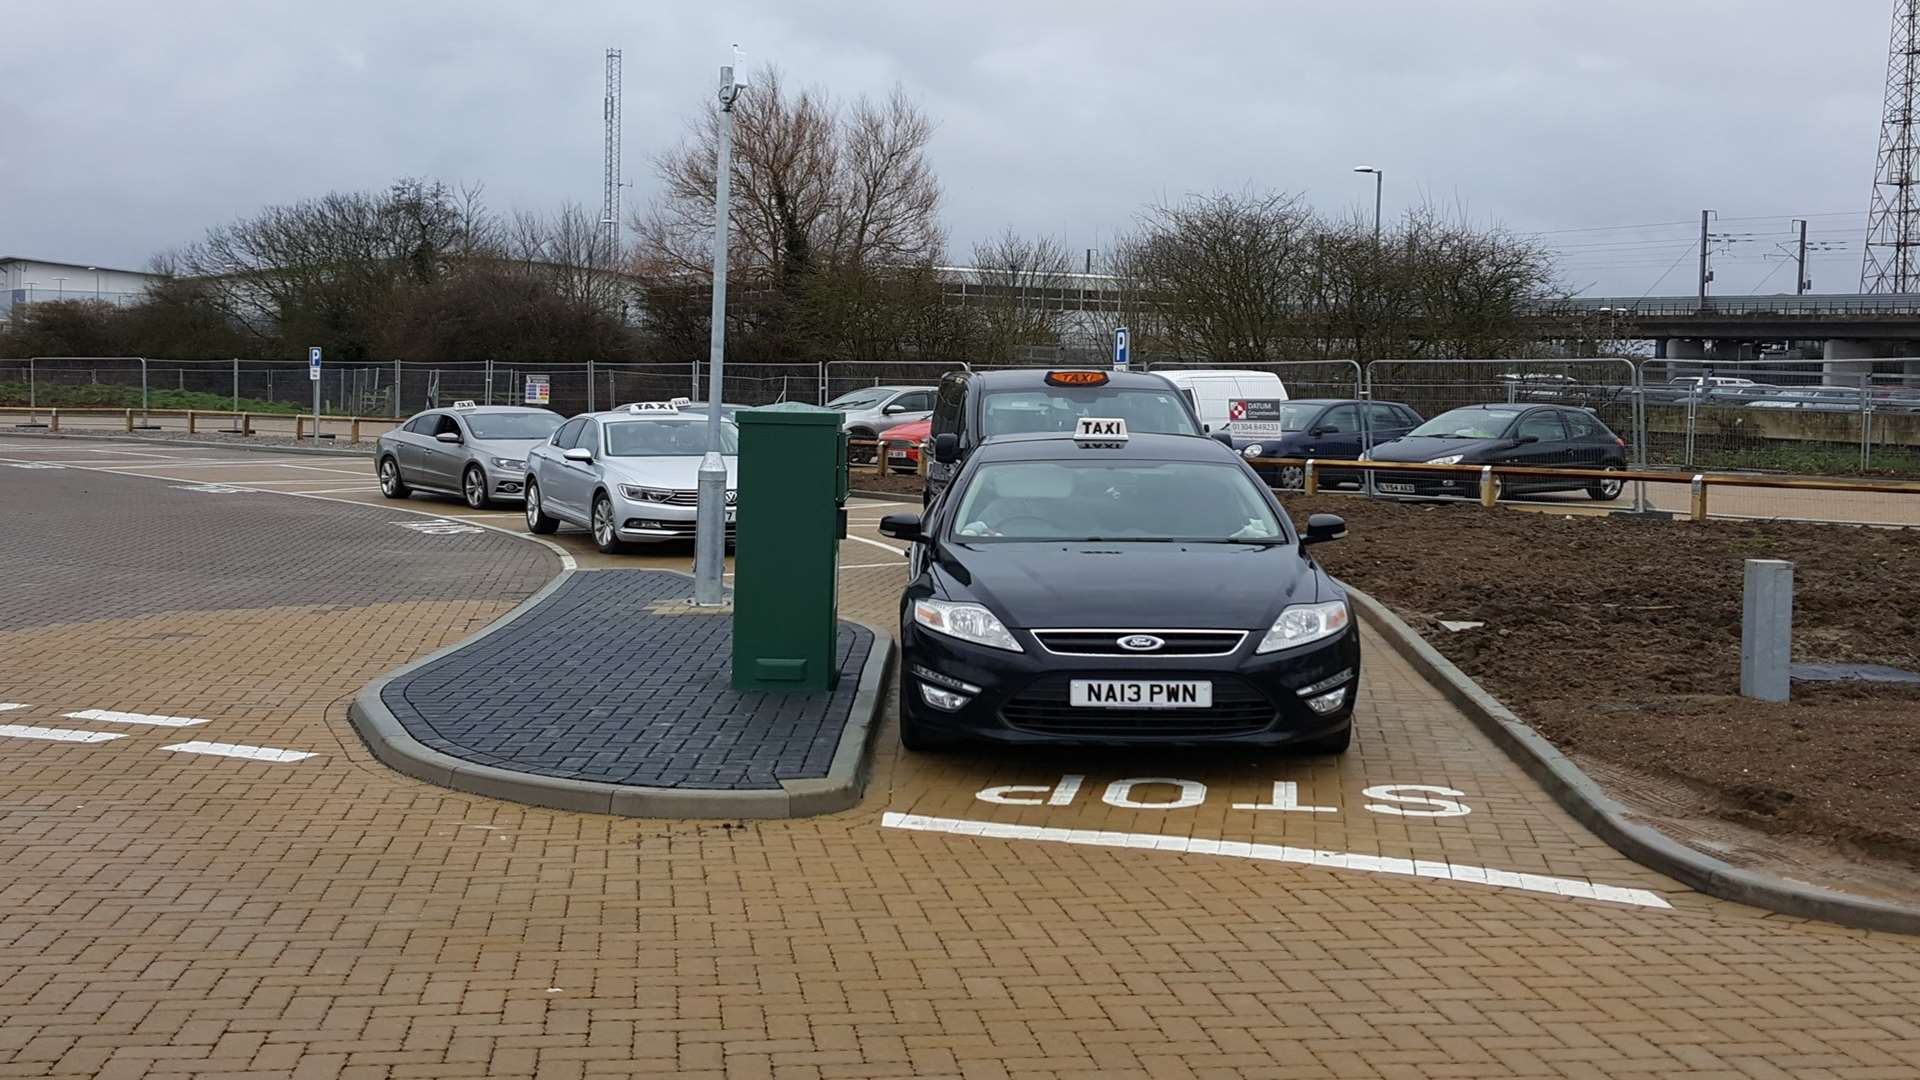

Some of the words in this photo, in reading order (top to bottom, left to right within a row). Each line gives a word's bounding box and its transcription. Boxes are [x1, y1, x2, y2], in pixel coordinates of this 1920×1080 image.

[1116, 331, 1125, 361] P
[312, 349, 320, 365] P
[1062, 374, 1094, 382] TAXI
[1082, 421, 1121, 434] TAXI
[1129, 637, 1152, 647] Ford
[1087, 683, 1142, 702] NA13
[1149, 684, 1197, 703] PWN
[975, 774, 1472, 817] STOP
